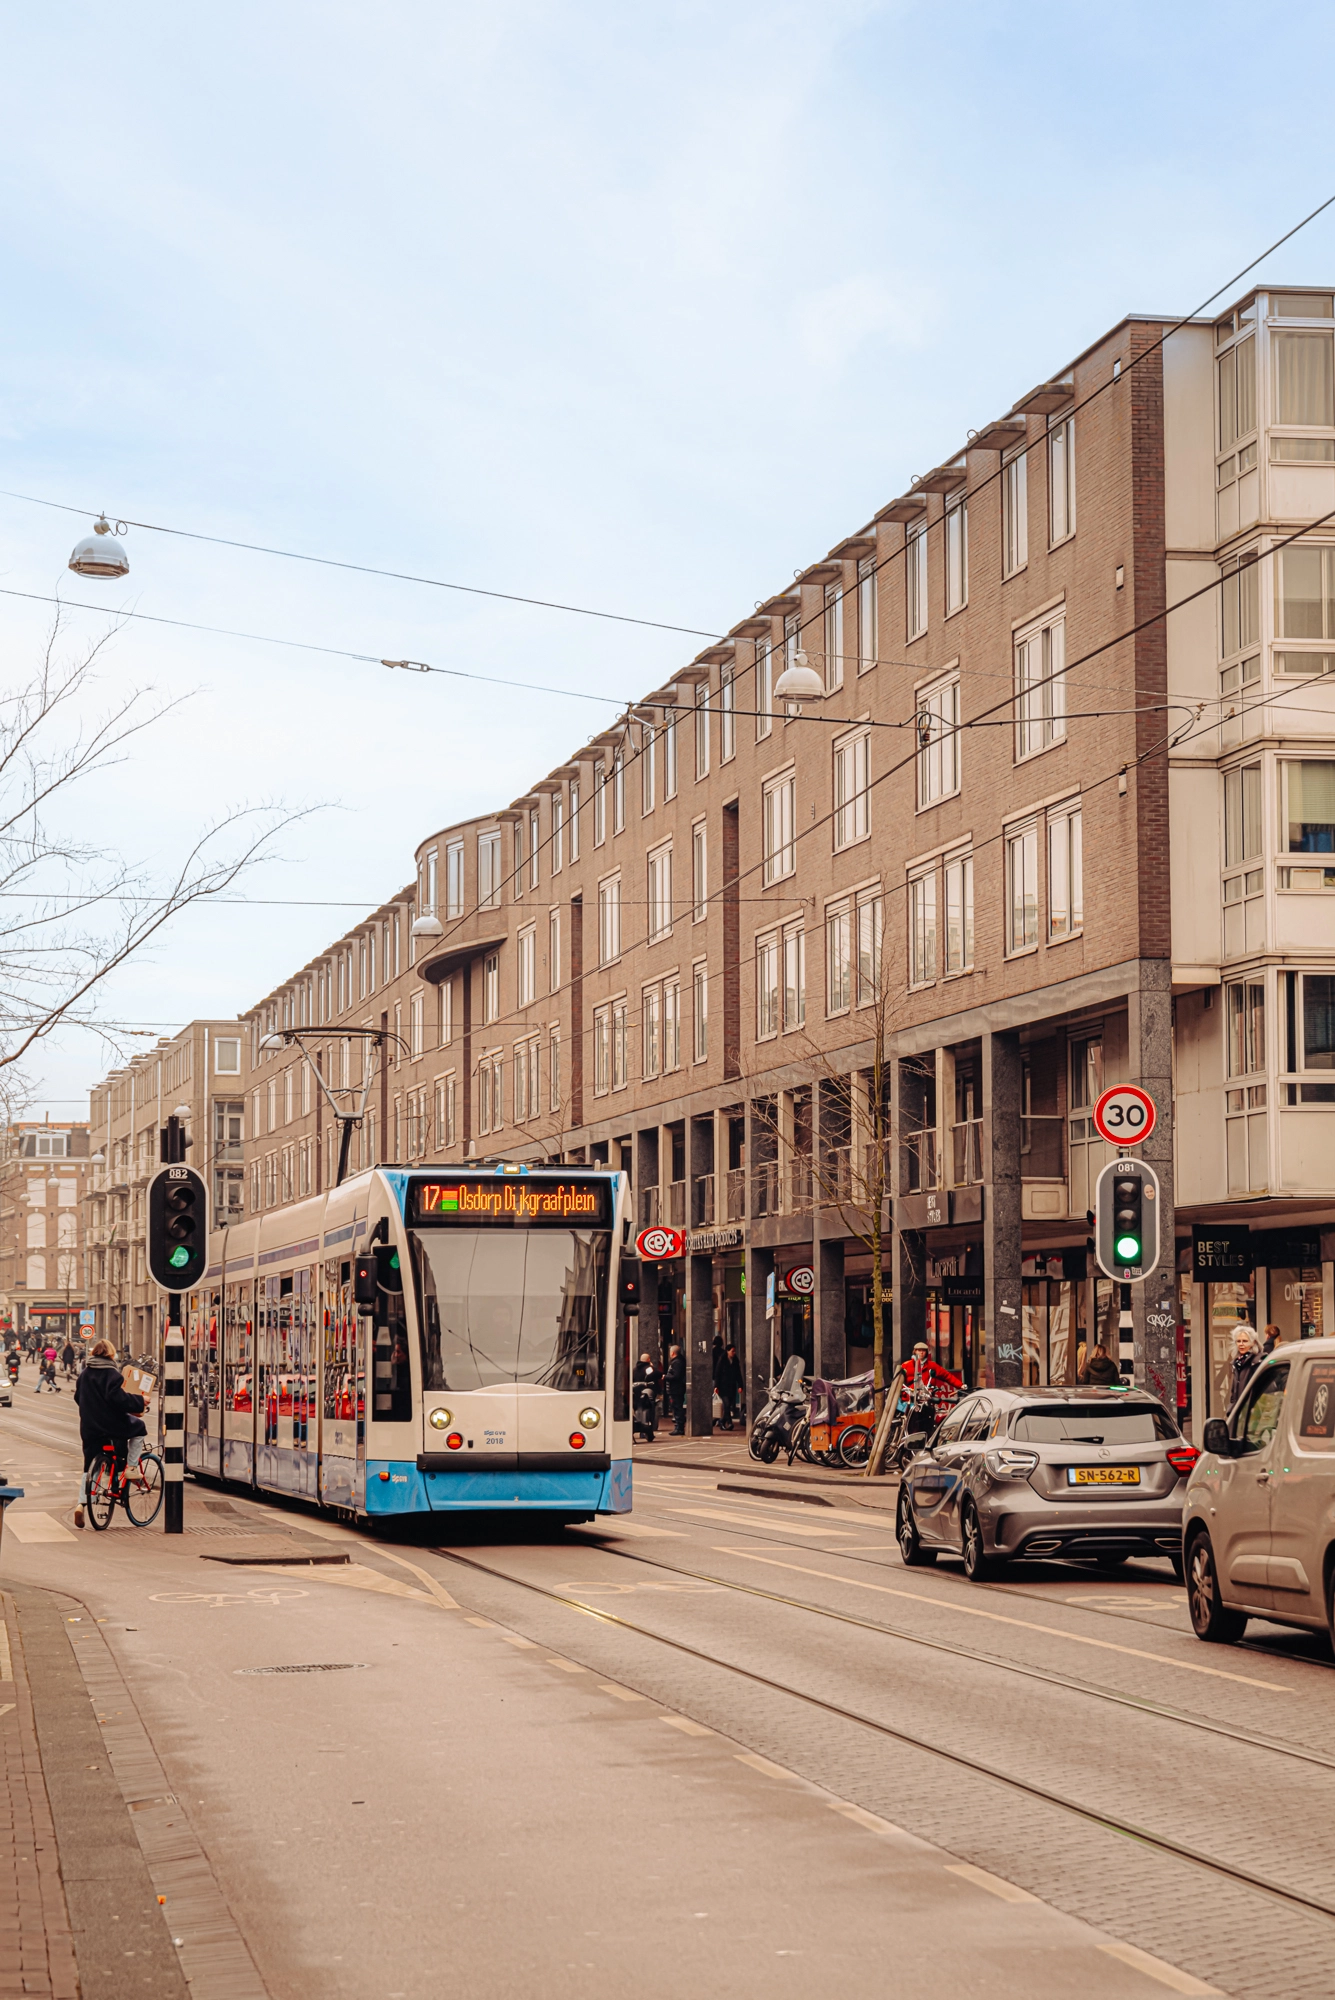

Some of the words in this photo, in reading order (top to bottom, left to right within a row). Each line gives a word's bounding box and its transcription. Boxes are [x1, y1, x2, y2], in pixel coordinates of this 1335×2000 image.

[1107, 1104, 1145, 1127] 30
[1118, 1163, 1134, 1172] 081
[169, 1169, 188, 1179] 082
[423, 1185, 440, 1211] 17
[459, 1185, 502, 1216] Osdorp
[1198, 1241, 1230, 1254] BEST
[1198, 1254, 1245, 1266] STYLES
[948, 1287, 981, 1296] Lucardi
[1284, 1284, 1307, 1302] ONLY
[1078, 1470, 1136, 1481] SN-562-R
